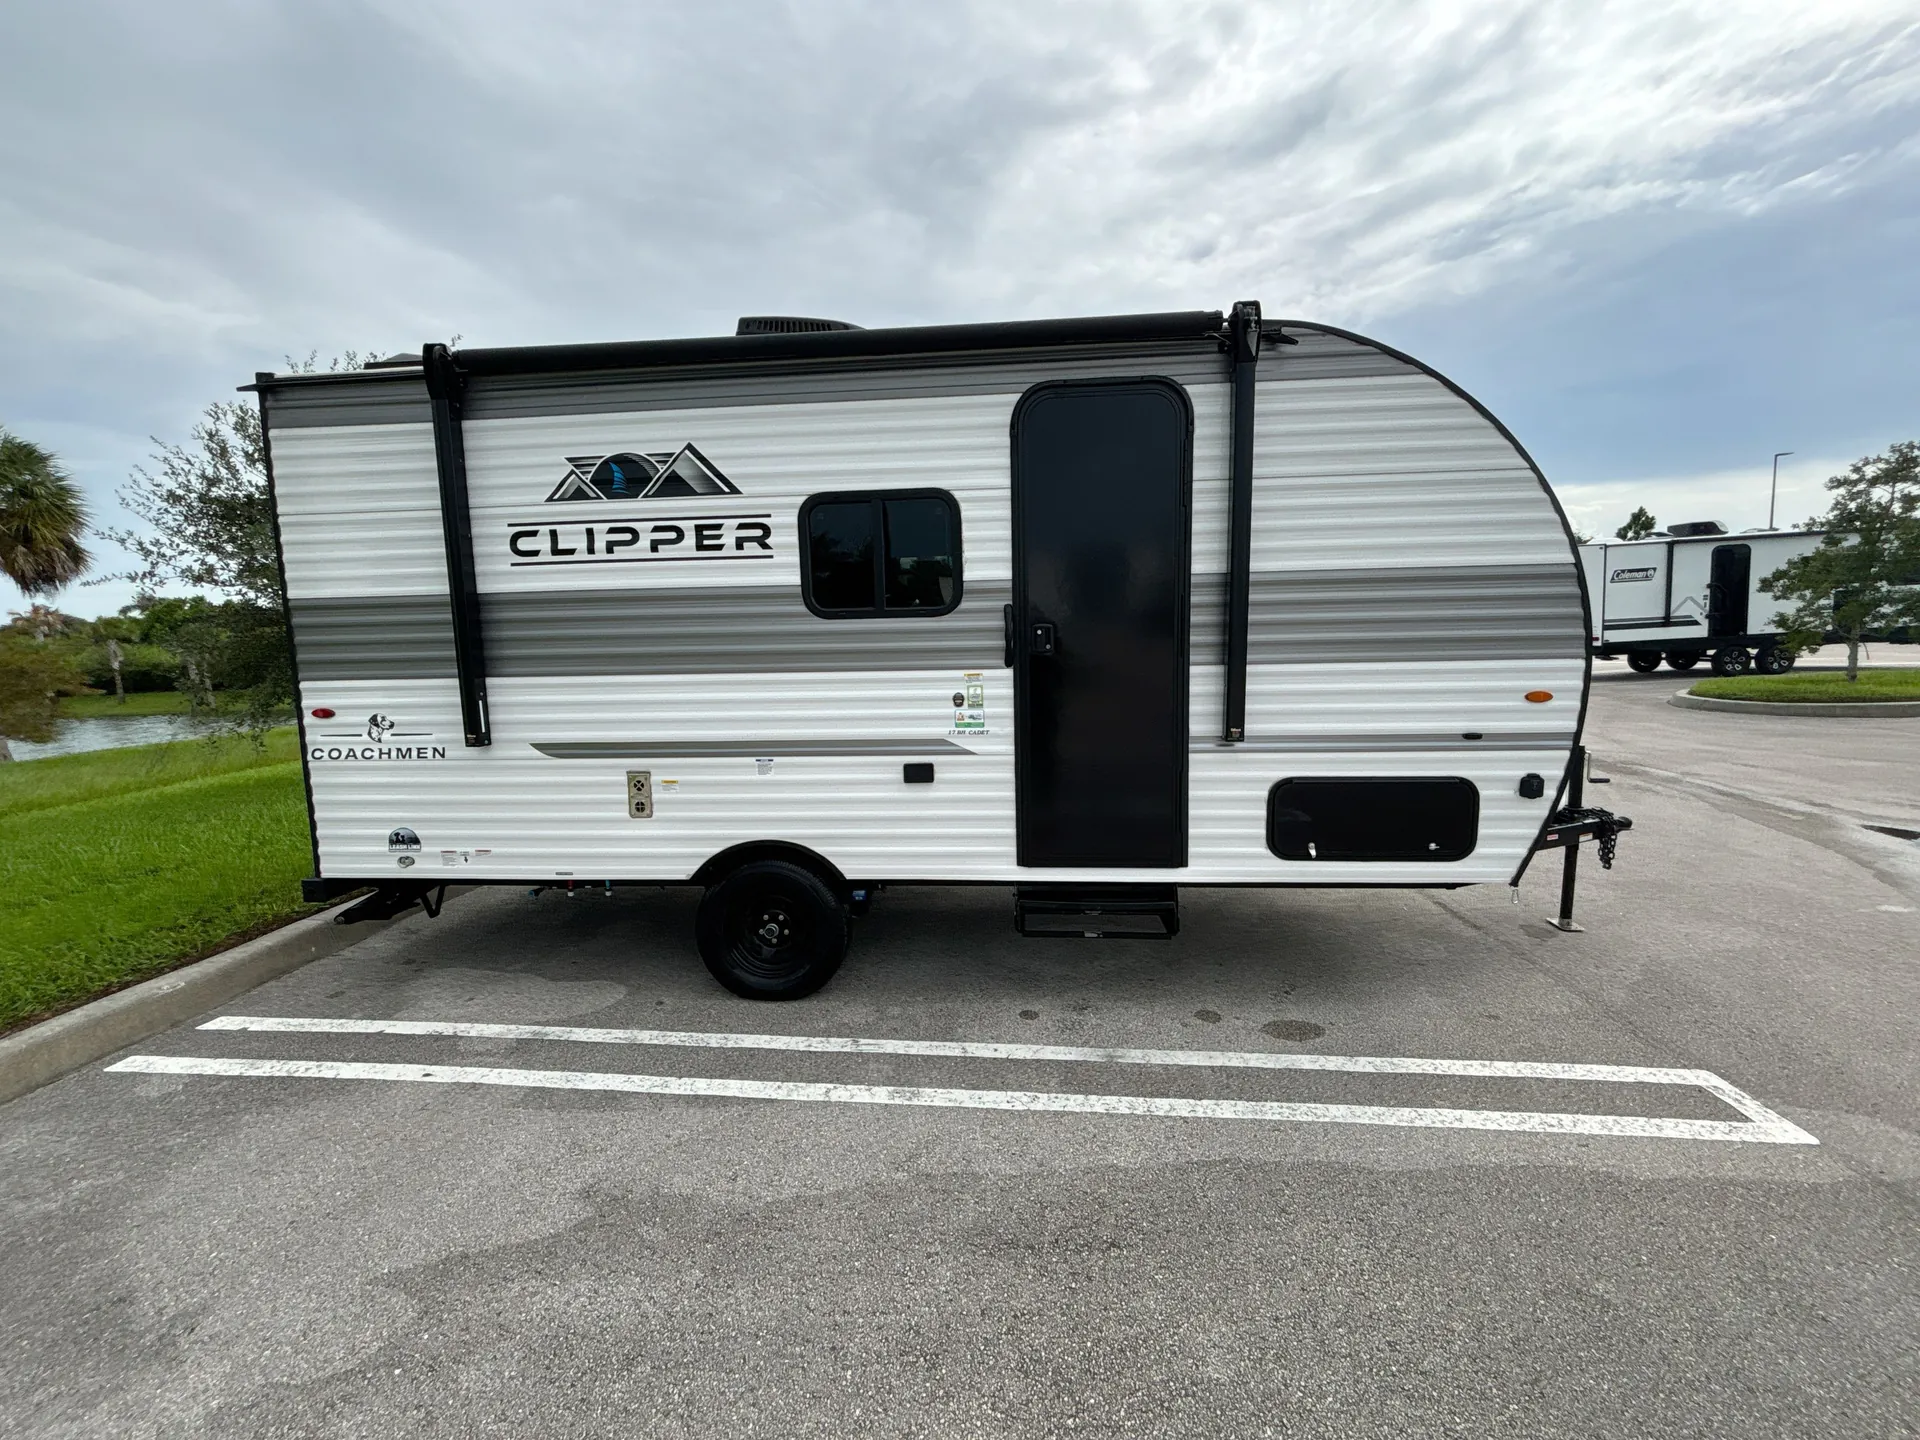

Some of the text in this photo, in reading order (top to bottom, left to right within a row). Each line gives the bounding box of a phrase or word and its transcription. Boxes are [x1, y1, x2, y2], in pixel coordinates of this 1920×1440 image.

[509, 521, 774, 558] CLIPPER
[1613, 570, 1647, 580] Coleman
[311, 746, 446, 760] COACHMEN
